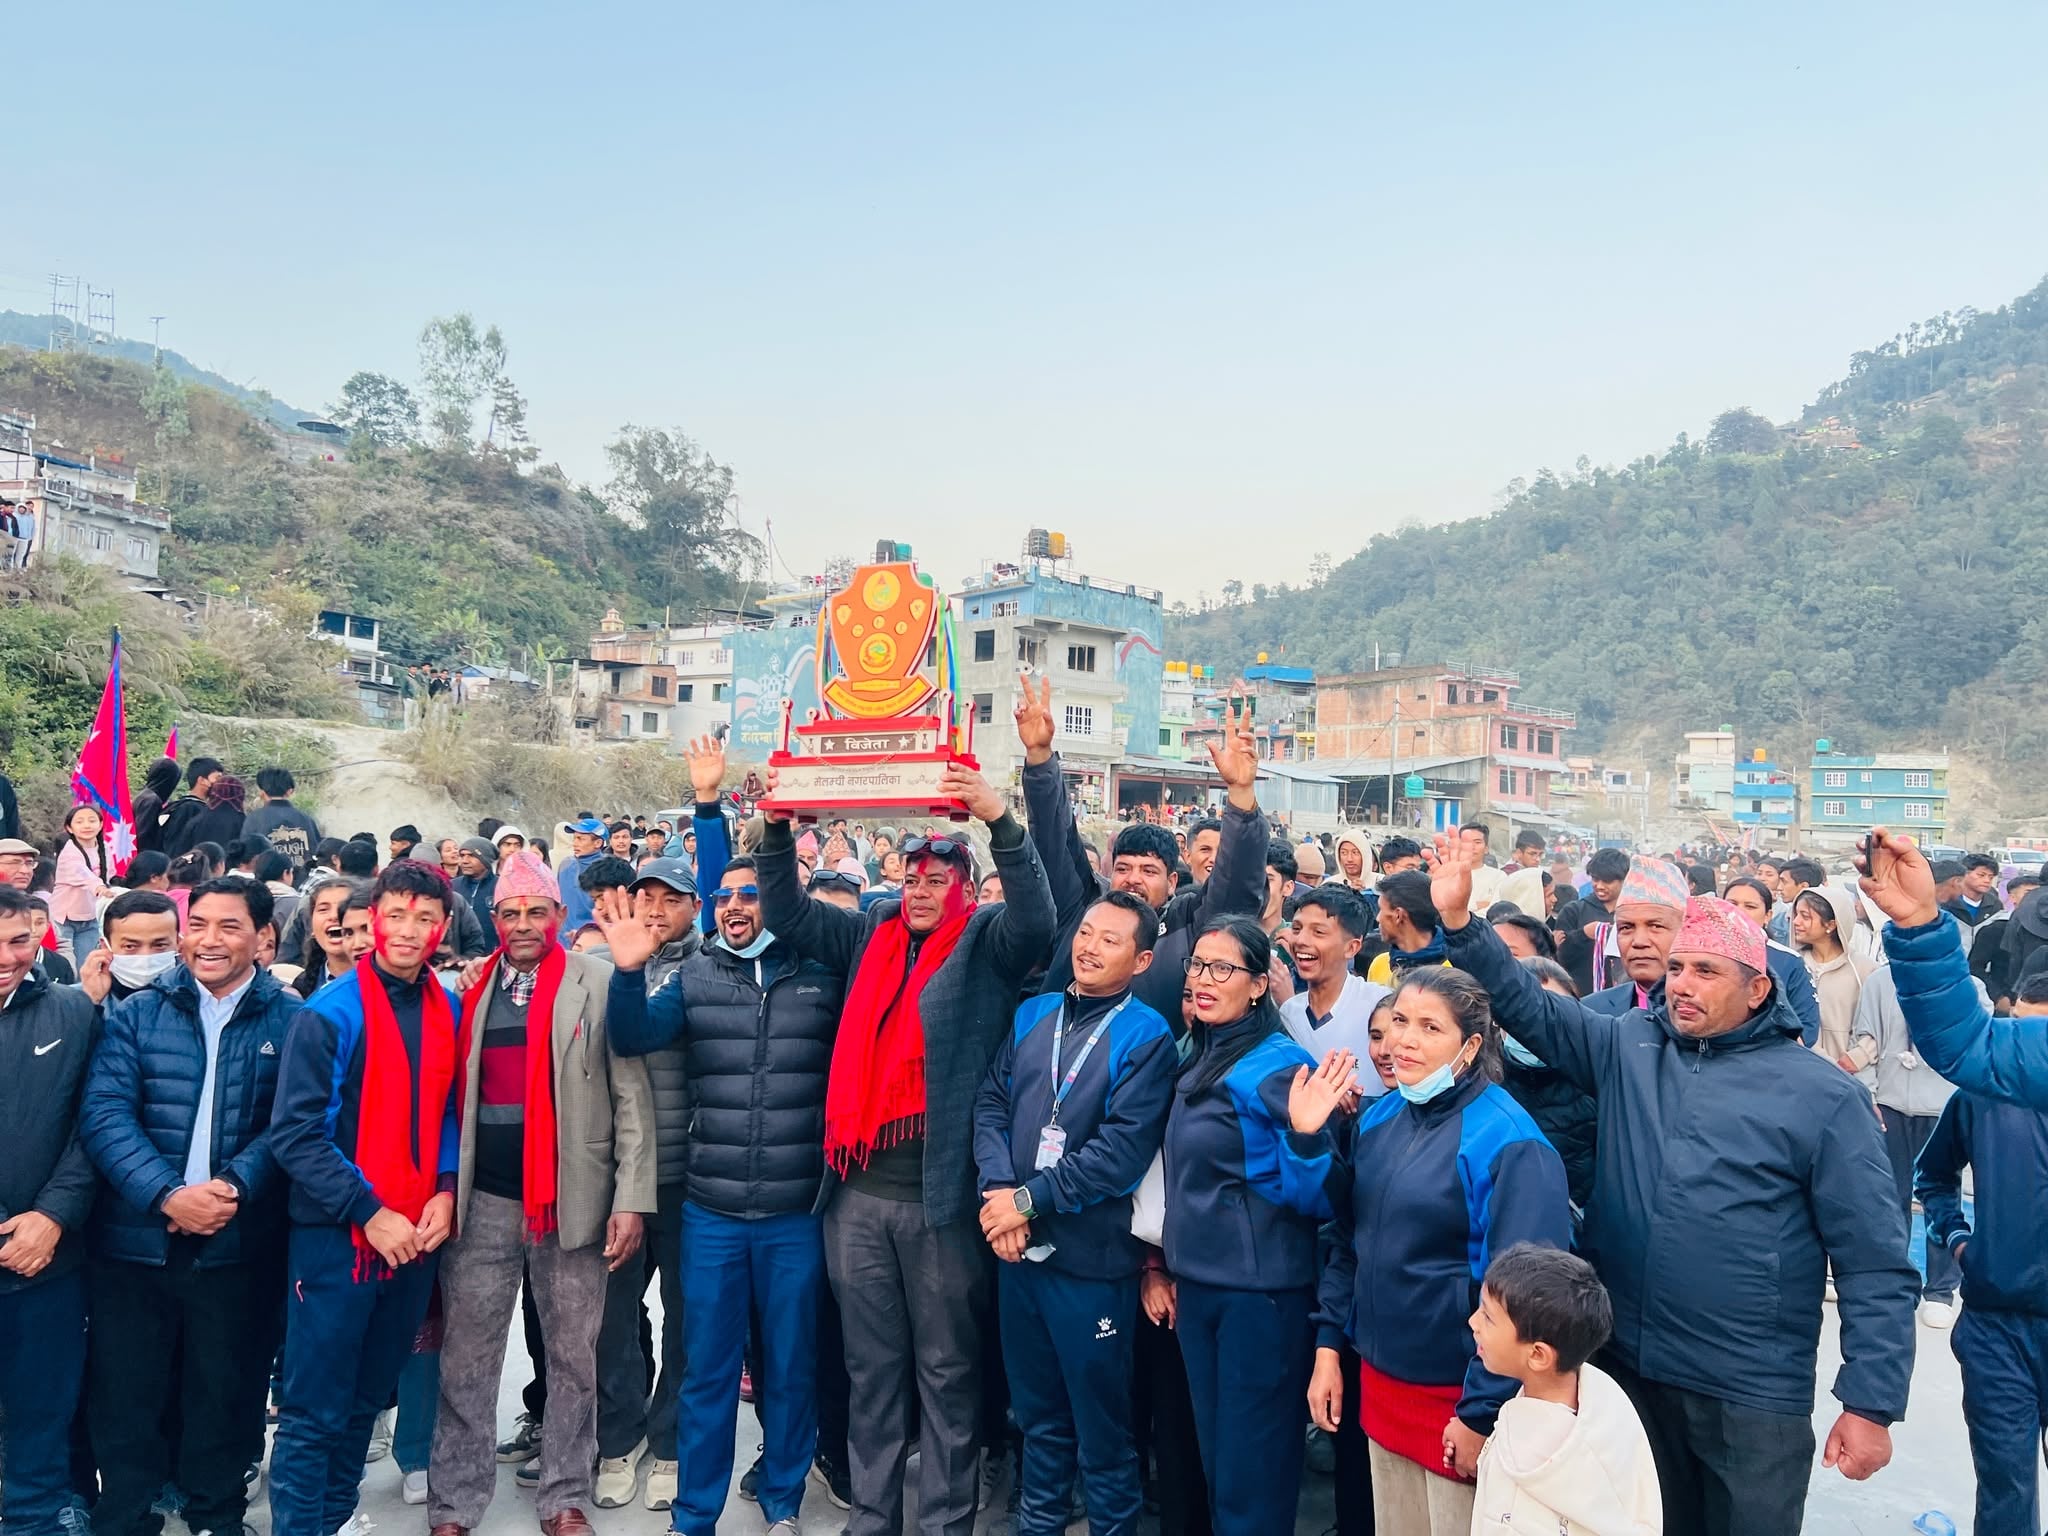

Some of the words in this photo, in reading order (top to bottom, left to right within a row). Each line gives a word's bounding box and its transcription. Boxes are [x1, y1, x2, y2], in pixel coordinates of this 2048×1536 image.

[844, 737, 890, 750] विजेता
[814, 774, 845, 787] मेलम्ची
[848, 773, 901, 786] नगरपालिका
